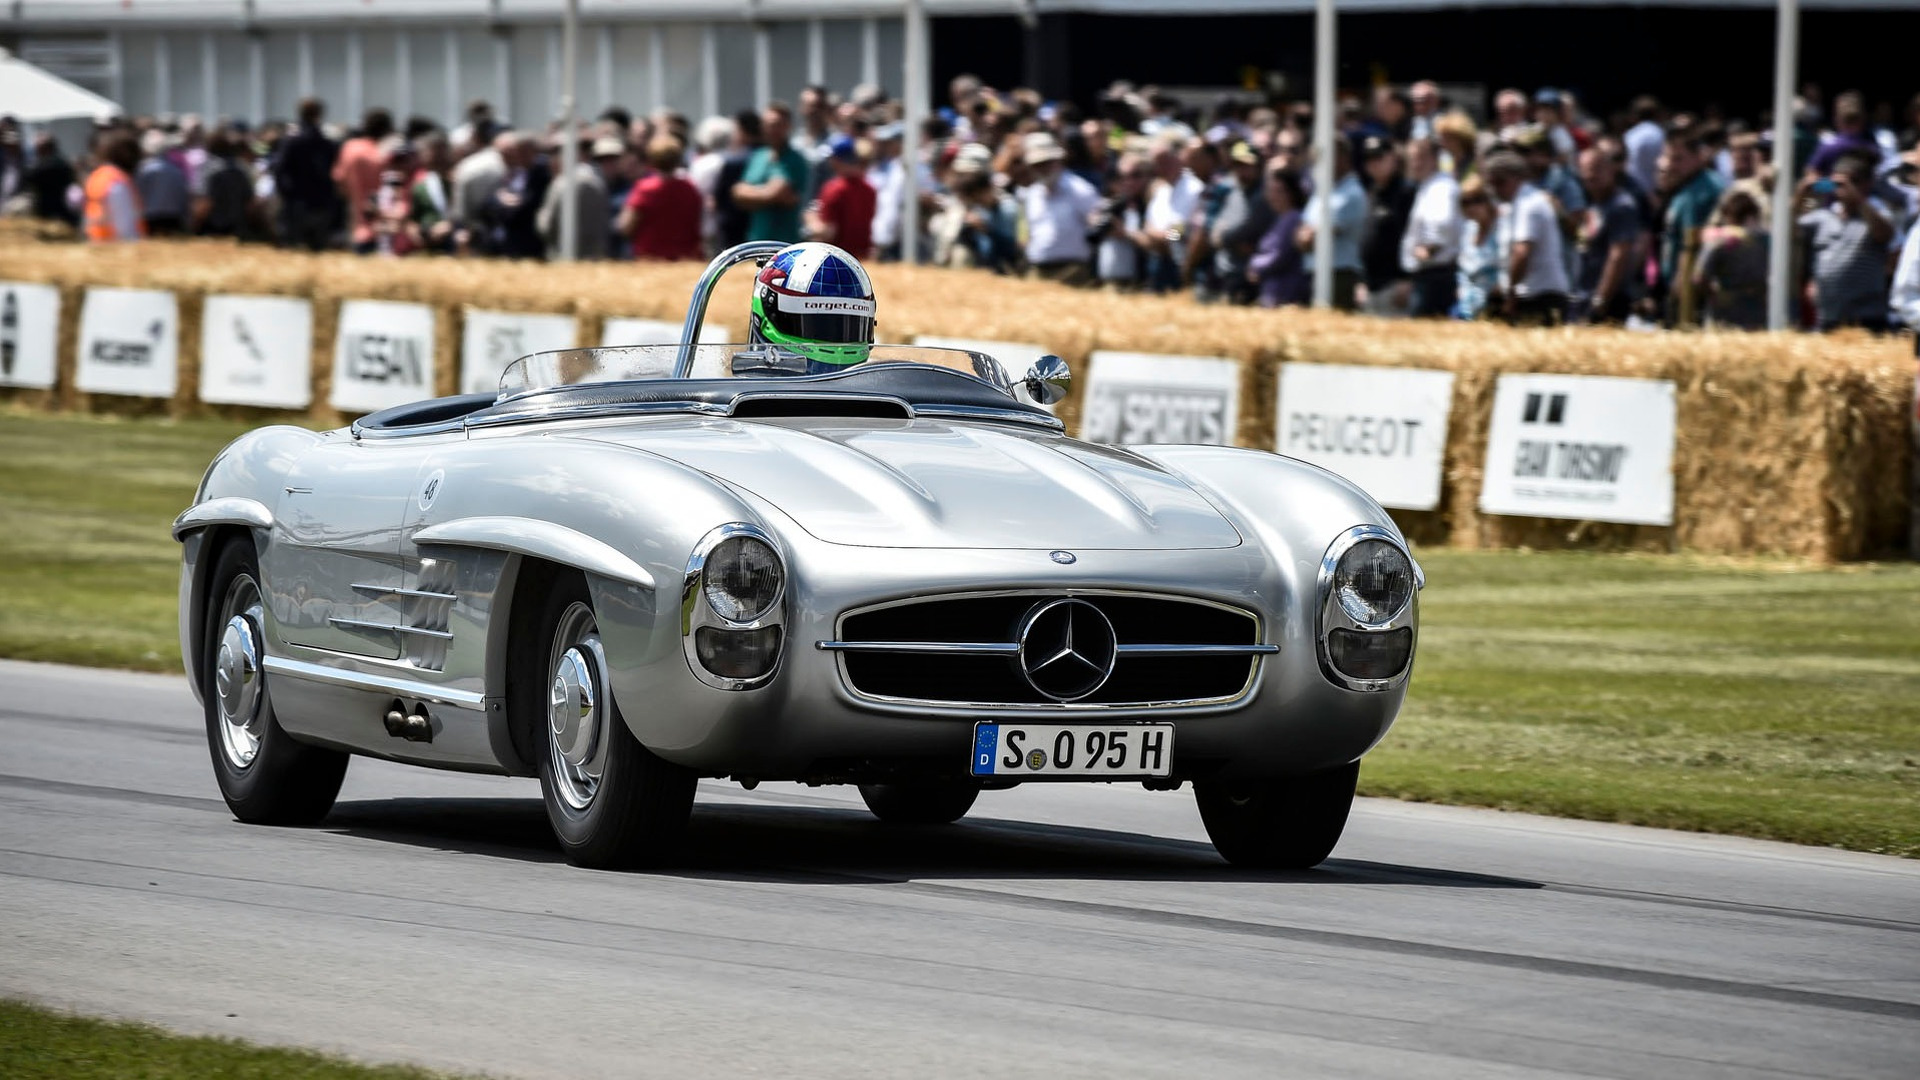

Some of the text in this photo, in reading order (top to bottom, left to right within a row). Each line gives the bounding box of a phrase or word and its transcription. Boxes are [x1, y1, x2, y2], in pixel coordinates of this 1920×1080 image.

[804, 301, 870, 312] target.com
[1289, 412, 1422, 457] PEUGEOT
[980, 753, 989, 766] D
[1003, 729, 1026, 769] S
[1085, 730, 1128, 769] 95
[1140, 731, 1164, 769] H
